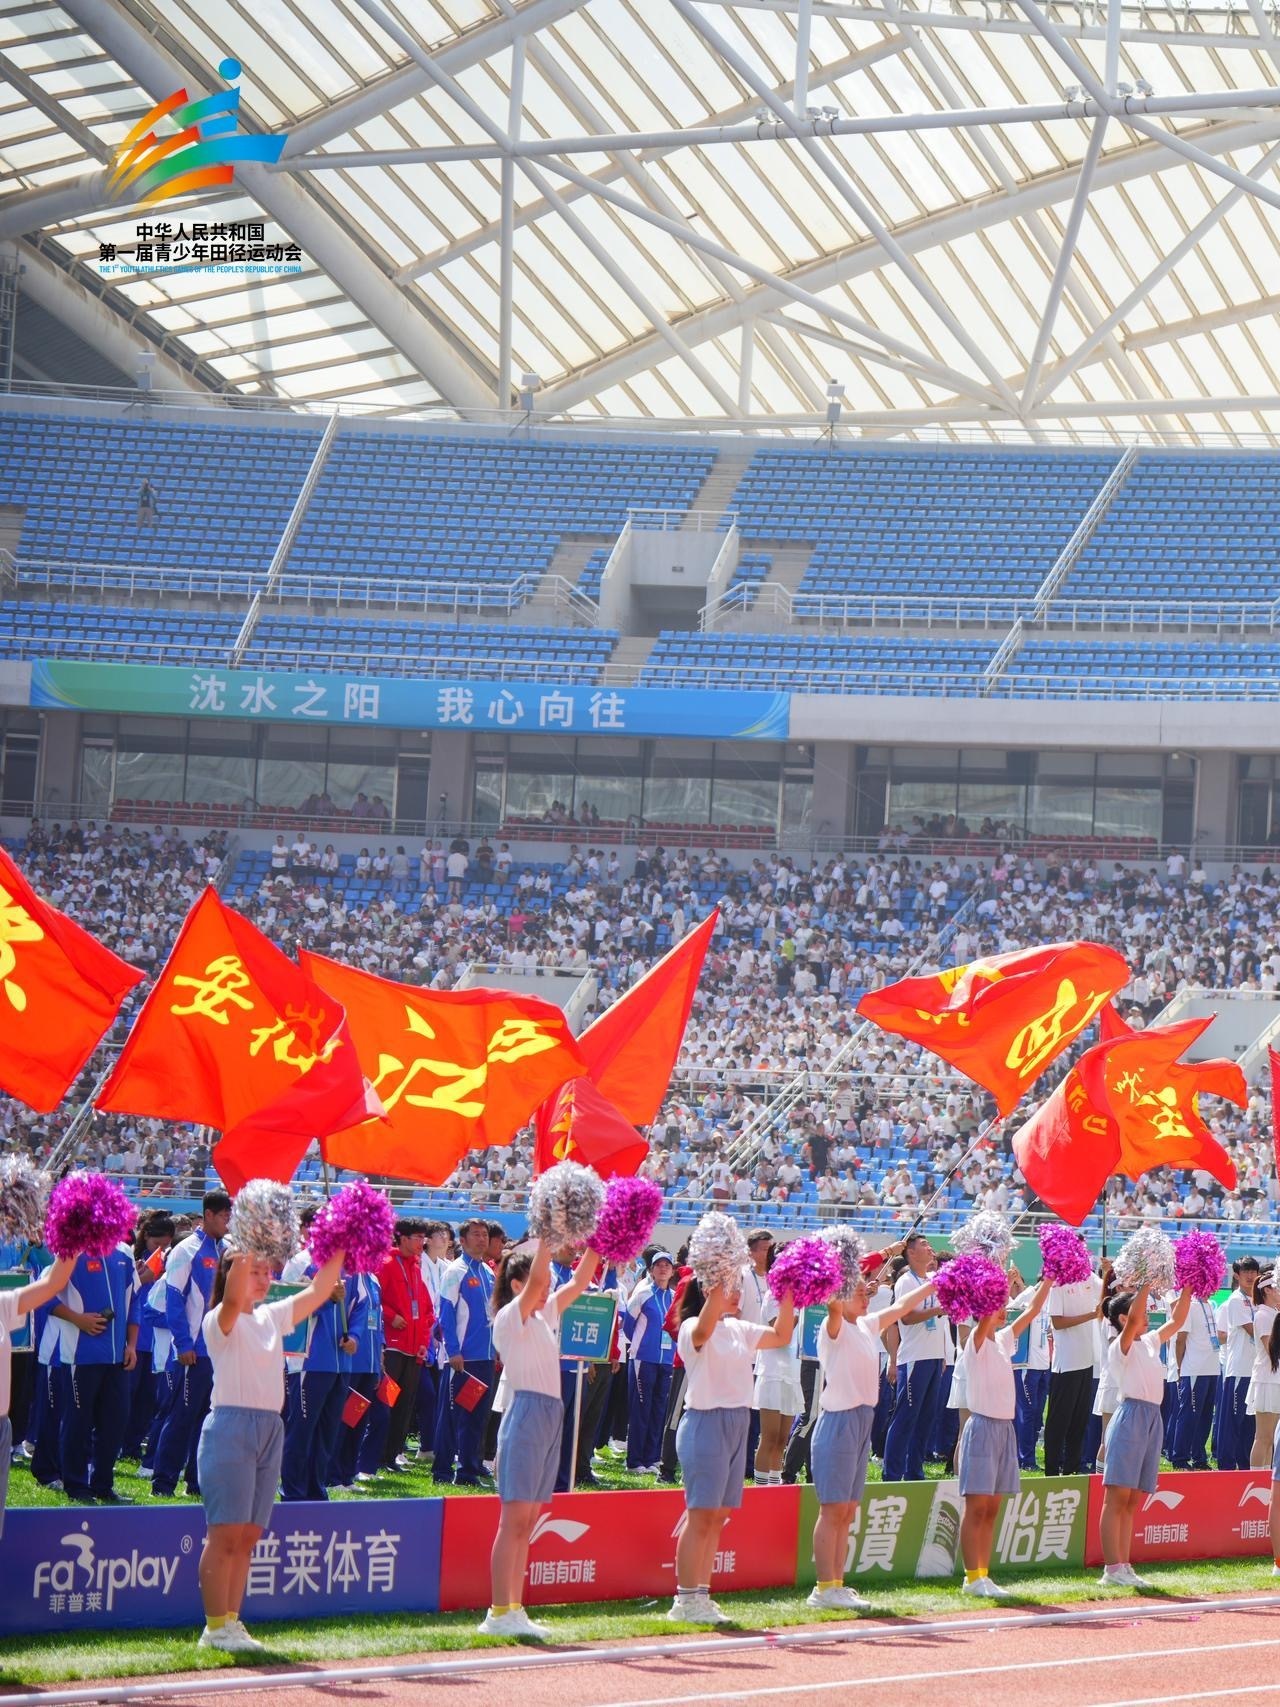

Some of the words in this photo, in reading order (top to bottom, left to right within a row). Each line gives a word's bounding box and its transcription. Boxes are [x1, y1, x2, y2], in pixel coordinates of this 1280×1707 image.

[188, 674, 381, 720] 沈水之阳
[437, 686, 627, 729] 我心向往
[571, 1320, 600, 1344] 江西
[1134, 1523, 1189, 1544] 一切皆有可能
[201, 1528, 401, 1598] 普莱体育
[49, 1591, 103, 1614] 菲普莱
